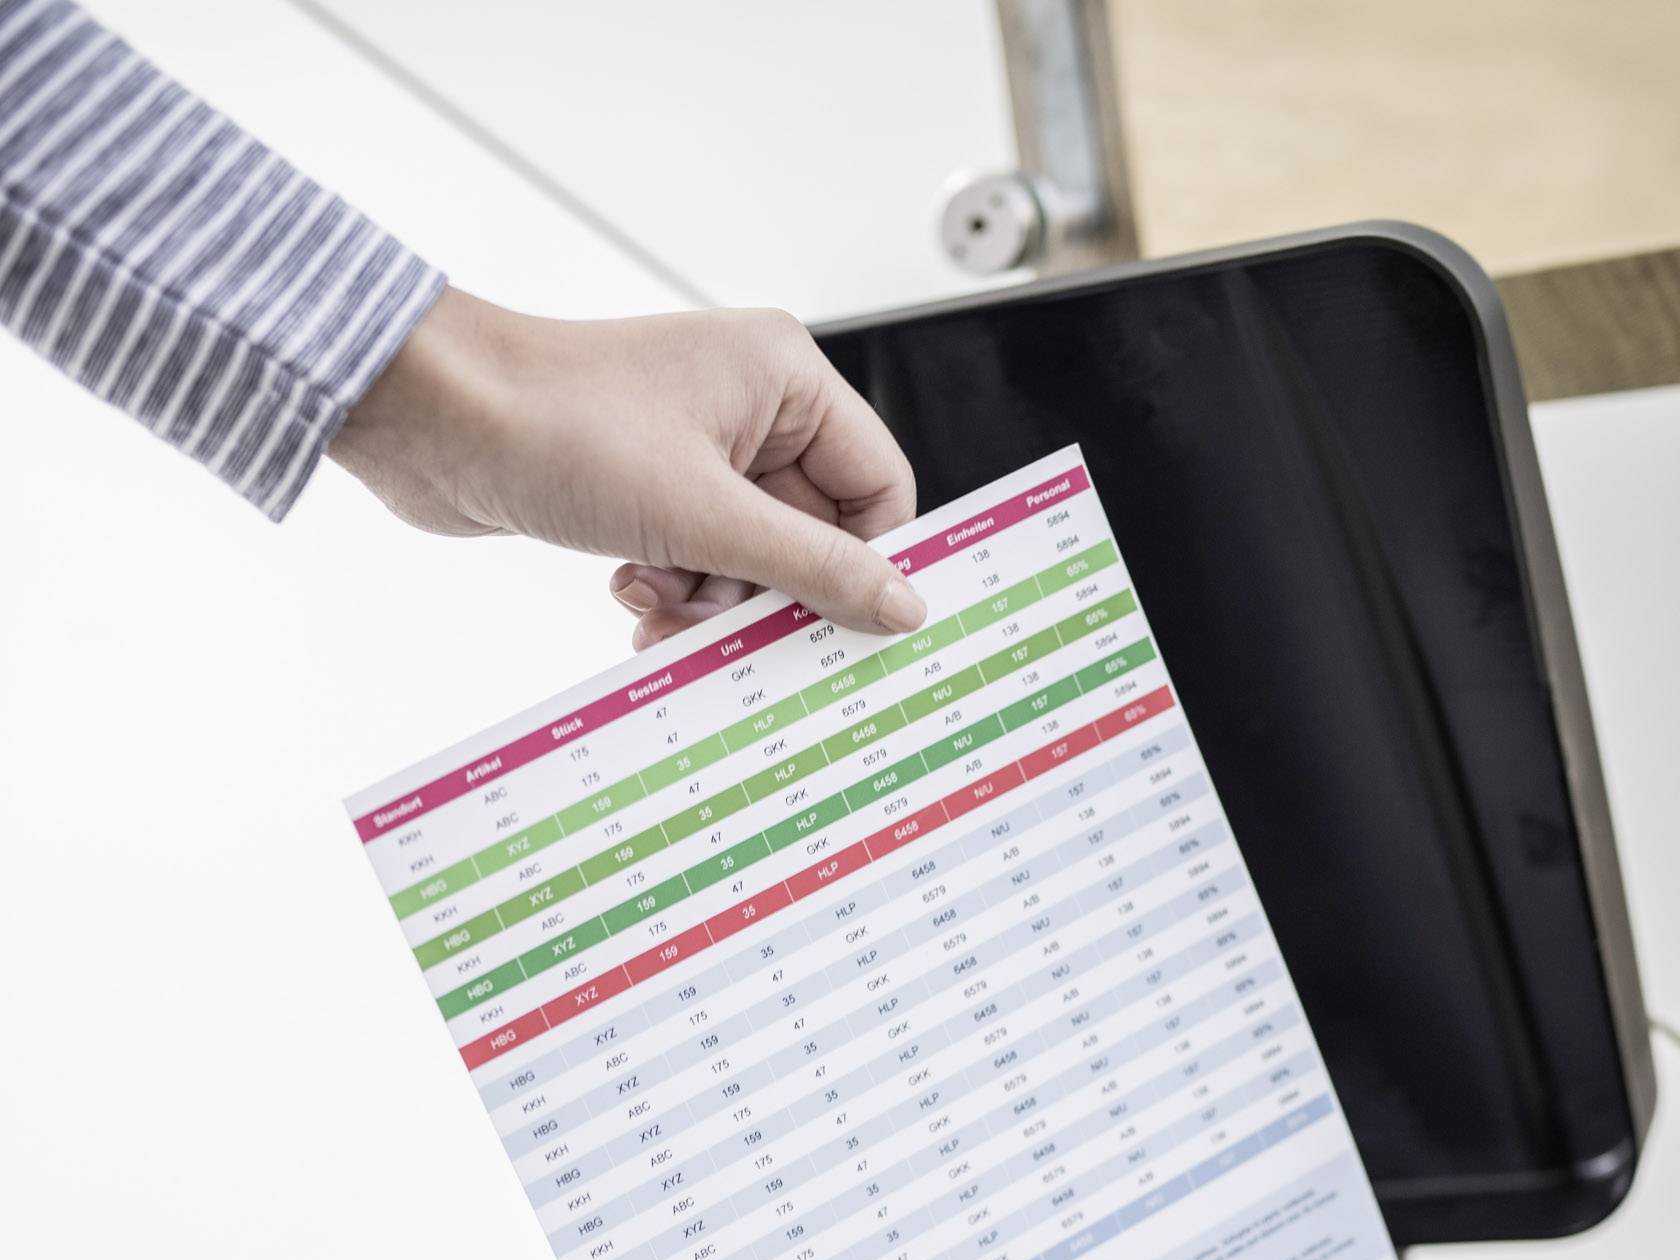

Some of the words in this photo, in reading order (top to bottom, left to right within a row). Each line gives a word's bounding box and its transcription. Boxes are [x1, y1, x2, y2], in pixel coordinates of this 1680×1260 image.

[465, 755, 503, 784] Artikel
[551, 717, 585, 741] Stück
[627, 671, 673, 703] Bestand
[719, 638, 744, 657] Unit
[945, 516, 995, 547] Einheiten
[1025, 478, 1072, 509] Personal
[569, 745, 590, 762] 175
[655, 705, 668, 720] 47
[730, 663, 753, 682] GKK
[809, 623, 835, 643] 6579
[971, 548, 991, 564] 138
[1045, 509, 1071, 528] 5894
[581, 770, 601, 788] 175
[666, 731, 679, 745] 47
[741, 688, 764, 707] GKK
[819, 649, 846, 668] 6579
[981, 572, 1001, 588] 138
[591, 795, 612, 813] 159
[676, 755, 692, 772] 35
[752, 712, 775, 733] HLP
[830, 673, 857, 695] 6458
[911, 634, 933, 654] N/U
[528, 885, 554, 908] XYZ
[614, 845, 635, 864] 159
[698, 805, 714, 822] 35
[773, 762, 796, 783] HLP
[851, 722, 878, 744] 6458
[931, 684, 953, 703] N/U
[541, 912, 565, 932] ABC
[625, 871, 646, 888] 175
[710, 830, 722, 844] 47
[784, 787, 806, 806] GKK
[862, 748, 888, 767] 6579
[944, 709, 963, 727] A/B
[603, 821, 624, 838] 175
[688, 781, 700, 795] 47
[763, 738, 785, 757] GKK
[841, 698, 867, 718] 6579
[923, 661, 942, 678] A/B
[489, 1028, 517, 1051] HBG
[574, 985, 599, 1007] XYZ
[659, 944, 679, 962] 159
[741, 903, 757, 920] 35
[816, 860, 839, 881] HLP
[893, 819, 920, 841] 6458
[973, 781, 994, 800] N/U
[551, 935, 577, 957] XYZ
[636, 895, 657, 913] 159
[719, 854, 735, 871] 35
[795, 811, 818, 832] HLP
[872, 771, 899, 793] 6458
[952, 733, 974, 752] N/U
[564, 962, 588, 982] ABC
[648, 920, 668, 937] 175
[731, 880, 744, 894] 47
[805, 836, 828, 856] GKK
[883, 796, 909, 816] 6579
[965, 758, 984, 775] A/B
[509, 1070, 536, 1091] HBG
[593, 1026, 618, 1047] XYZ
[677, 985, 698, 1002] 159
[759, 944, 775, 960] 35
[834, 901, 857, 920] HLP
[521, 1095, 547, 1115] KKH
[605, 1051, 629, 1072] ABC
[688, 1009, 709, 1026] 175
[771, 968, 784, 983] 47
[844, 925, 867, 944] GKK
[532, 1119, 559, 1140] HBG
[616, 1075, 640, 1095] XYZ
[699, 1034, 720, 1050] 159
[781, 993, 797, 1008] 35
[856, 949, 878, 968] HLP
[544, 1143, 569, 1163] KKH
[627, 1100, 652, 1120] ABC
[710, 1058, 731, 1075] 175
[793, 1016, 805, 1030] 47
[866, 973, 890, 992] GKK
[555, 1167, 582, 1188] HBG
[639, 1123, 660, 1144] XYZ
[721, 1082, 741, 1099] 159
[803, 1041, 818, 1056] 35
[577, 1216, 604, 1236] HBG
[660, 1171, 684, 1192] XYZ
[743, 1129, 763, 1146] 159
[824, 1088, 839, 1104] 35
[589, 1240, 614, 1260] KKH
[672, 1196, 696, 1216] ABC
[754, 1153, 774, 1170] 175
[835, 1112, 847, 1126] 47
[785, 1224, 805, 1241] 159
[865, 1182, 880, 1198] 35
[876, 1205, 888, 1219] 47
